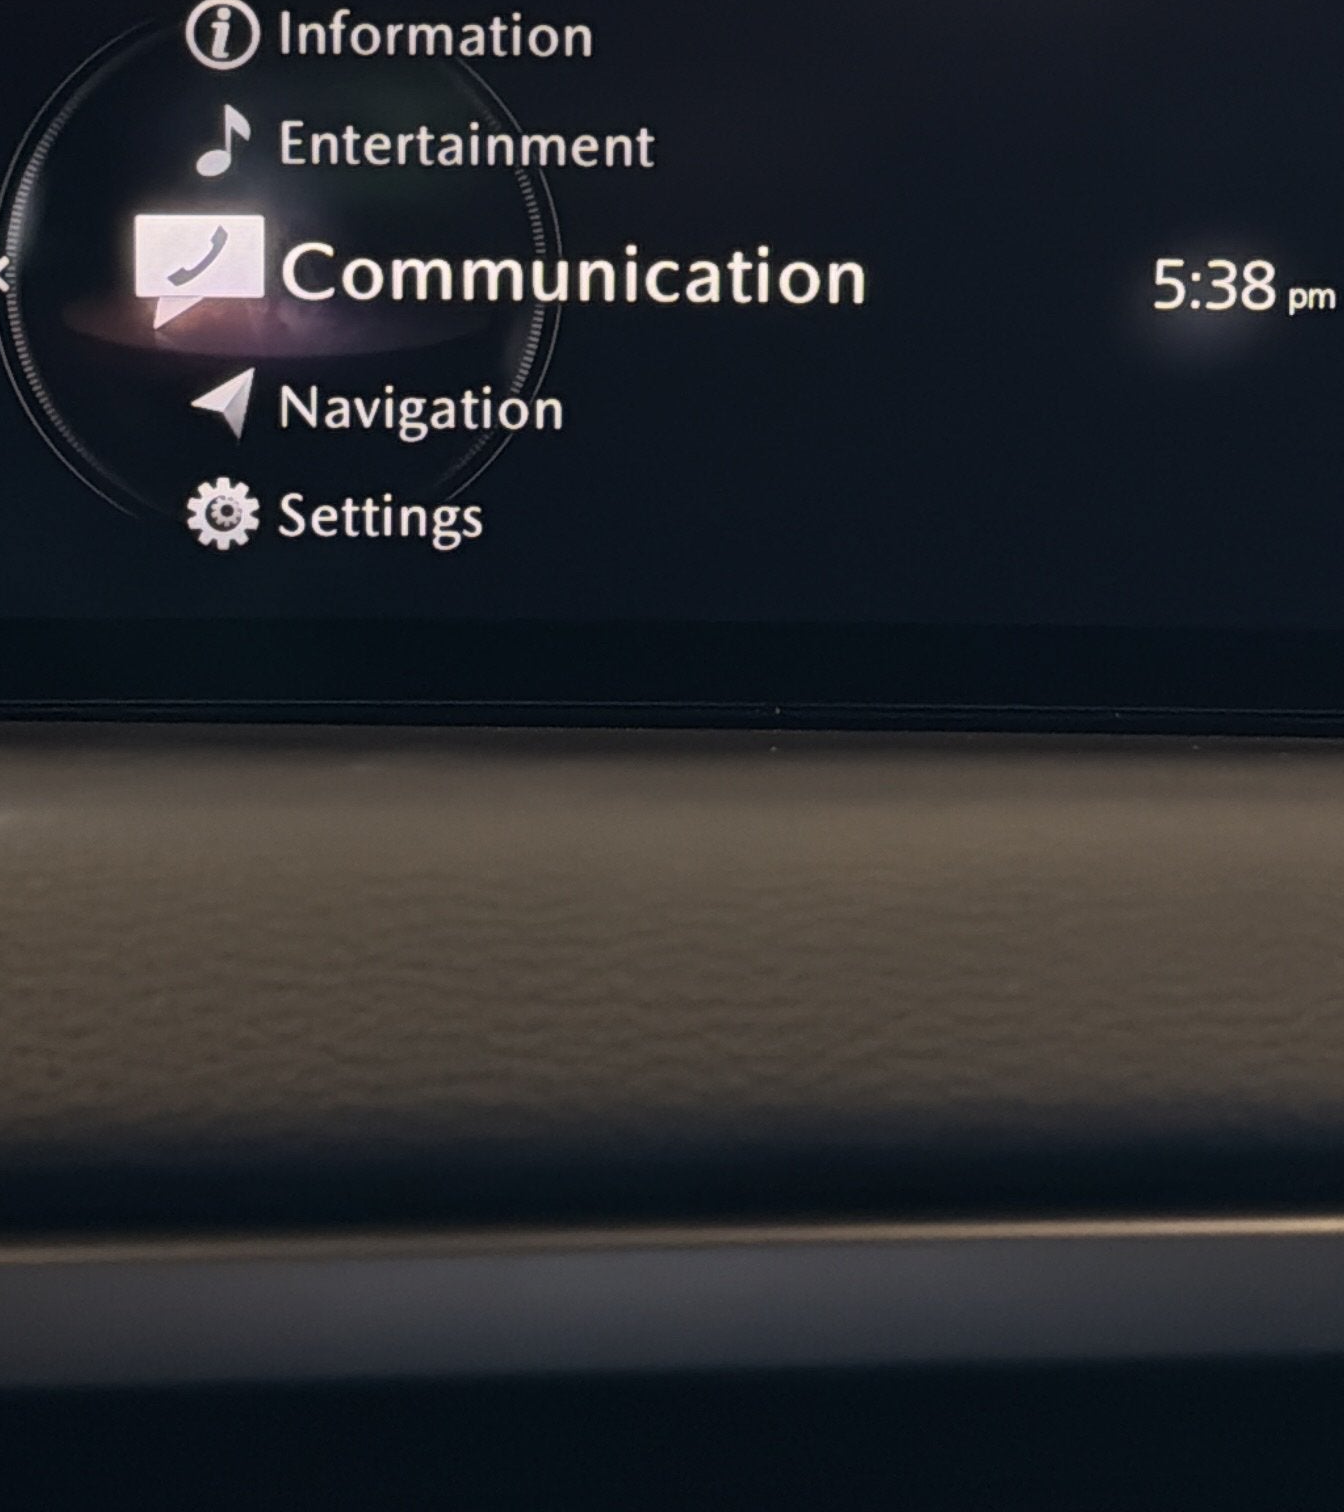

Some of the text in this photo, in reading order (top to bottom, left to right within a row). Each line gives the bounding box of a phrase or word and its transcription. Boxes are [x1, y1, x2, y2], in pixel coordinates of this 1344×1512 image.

[280, 8, 593, 59] Information
[280, 119, 656, 169] Entertainment
[282, 241, 866, 306] Communication
[1153, 257, 1337, 316] 5:38 pm
[279, 382, 564, 442] Navigation
[278, 492, 484, 551] Settings
